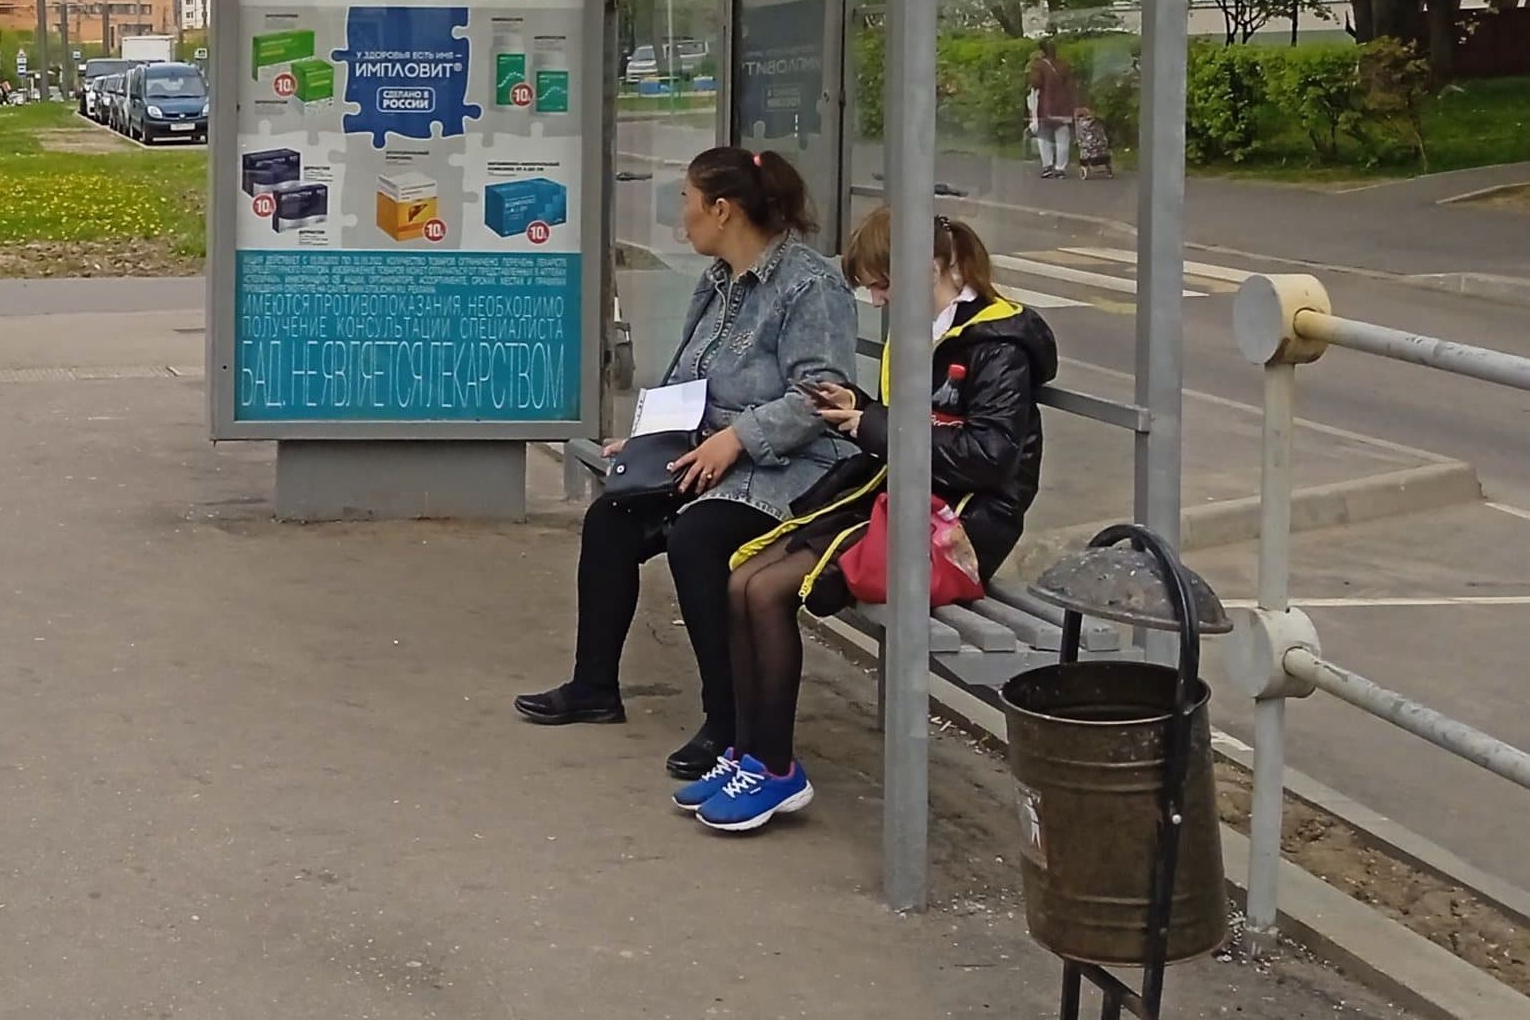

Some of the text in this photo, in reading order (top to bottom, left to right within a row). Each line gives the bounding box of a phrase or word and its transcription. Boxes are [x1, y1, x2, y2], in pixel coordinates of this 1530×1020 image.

[382, 90, 422, 99] СДЕЛАНО
[382, 99, 429, 109] РОССИИ
[242, 293, 309, 316] ИМЕЮТСЯ
[468, 295, 565, 318] НЕОБХОДИМО
[242, 315, 564, 340] ПОЛУЧЕНИЕ КОНСУЛЬТАЦИИ СПЕЦИАЛИСТА
[291, 340, 319, 407] НЕ
[321, 340, 423, 408] ЯВЛЯЕТСЯ
[426, 341, 564, 409] ЛЕКАРСТВОМ
